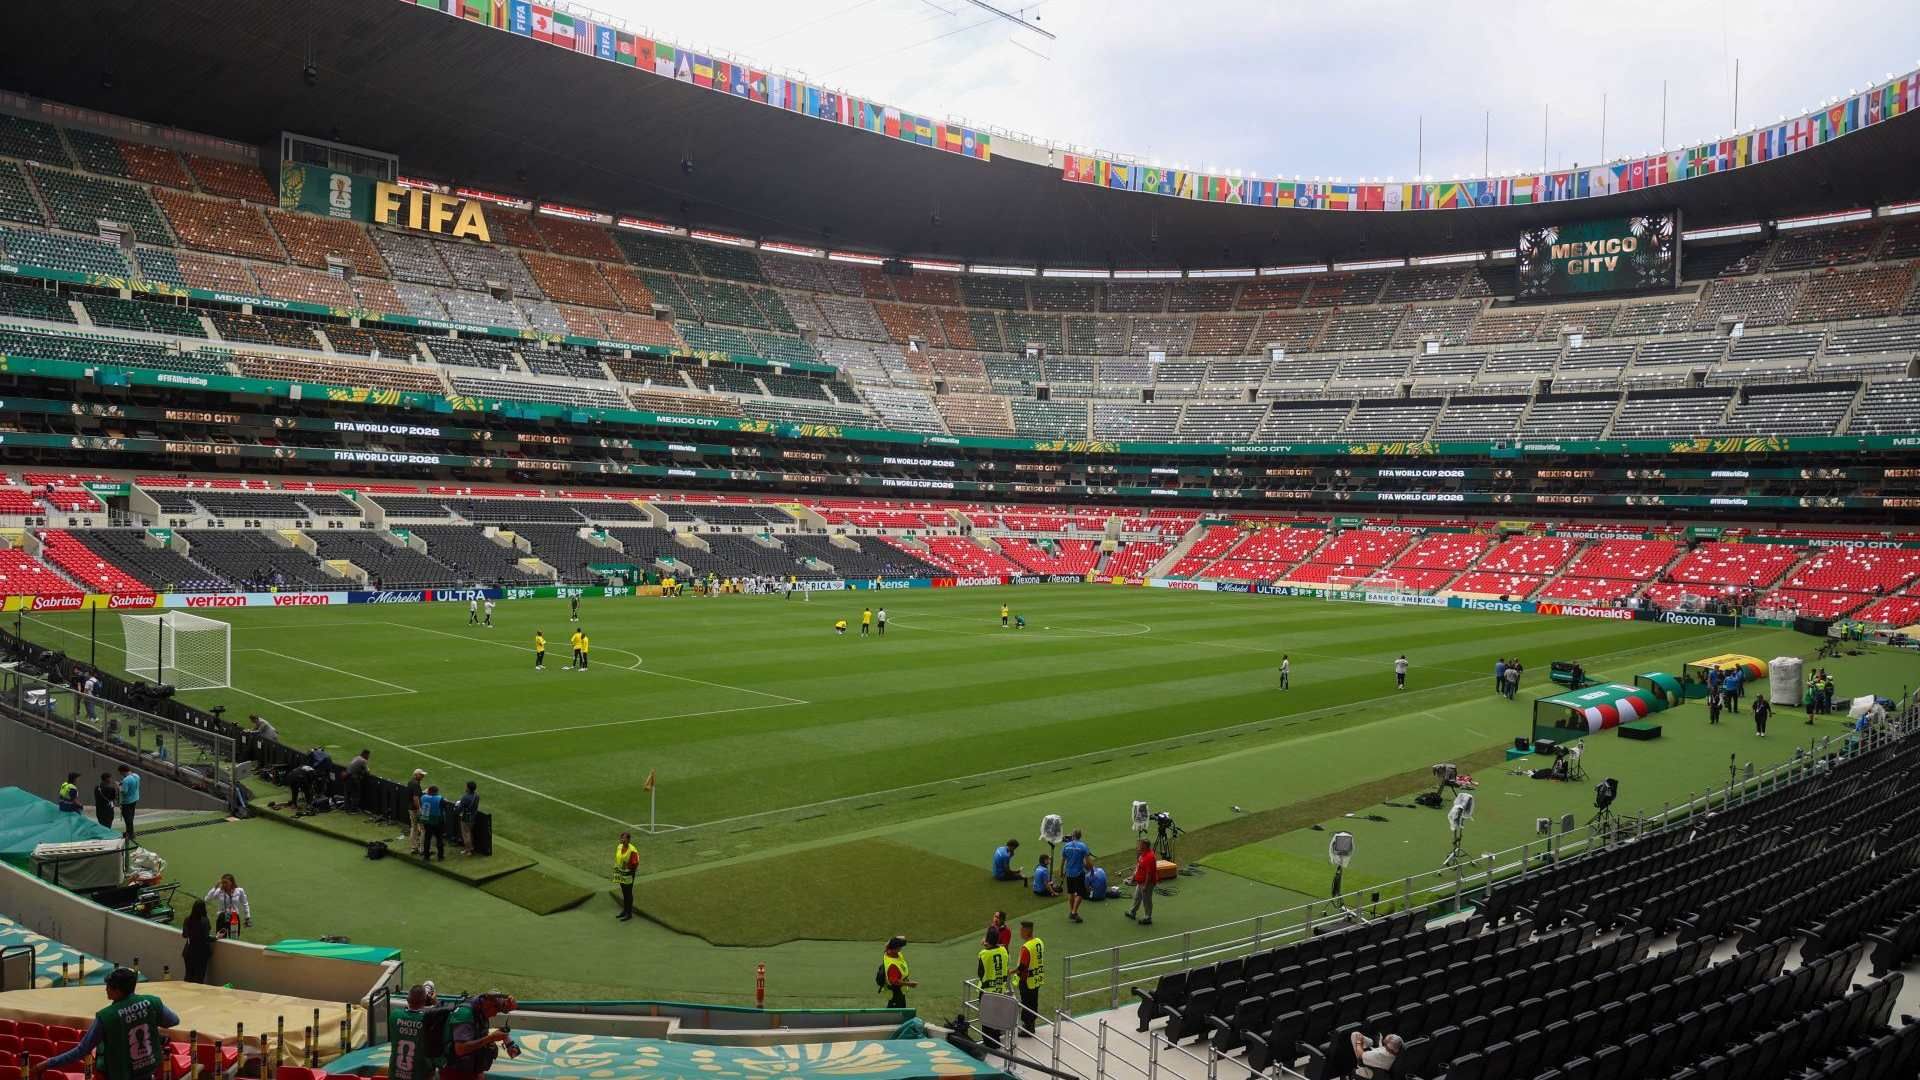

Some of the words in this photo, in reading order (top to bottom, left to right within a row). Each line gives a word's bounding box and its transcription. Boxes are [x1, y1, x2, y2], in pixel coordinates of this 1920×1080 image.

[517, 5, 527, 31] FIFA
[602, 31, 611, 56] FIFA
[375, 181, 491, 243] FIFA
[1551, 236, 1638, 260] MEXICO
[1567, 256, 1619, 275] CITY
[214, 293, 260, 305] MEXICO
[262, 300, 289, 309] CITY
[418, 319, 432, 327] FIFA
[432, 321, 454, 330] WORLD
[597, 341, 629, 350] MEXICO
[157, 374, 208, 386] #FIFAWorldCup
[166, 410, 212, 422] MEXICO
[214, 413, 241, 424] CITY
[656, 415, 695, 424] MEXICO
[696, 418, 720, 426] CITY
[334, 421, 355, 431] FIFA
[356, 423, 389, 433] WORLD
[390, 425, 408, 434] CUP
[409, 427, 440, 436] 2026
[517, 434, 551, 444] MEXICO
[552, 436, 572, 444] CITY
[166, 442, 212, 454] MEXICO
[214, 445, 241, 456] CITY
[334, 451, 355, 460] FIFA
[356, 453, 389, 462] WORLD
[390, 454, 408, 463] CUP
[409, 455, 440, 465] 2026
[783, 451, 810, 460] MEXICO
[517, 461, 551, 470] MEXICO
[552, 462, 572, 471] CITY
[897, 458, 919, 466] WORLD
[1537, 470, 1572, 478] MEXICO
[897, 480, 918, 488] WORLD
[1421, 493, 1437, 501] CUP
[1536, 495, 1571, 503] MEXICO
[1808, 539, 1865, 548] MEXICO
[868, 579, 910, 589] Hsense
[956, 575, 1002, 586] McDonald's
[1016, 574, 1040, 584] Rexona
[1052, 574, 1080, 583] Rexona
[1168, 580, 1199, 590] verizon
[1257, 585, 1289, 595] ULTRA
[34, 595, 82, 609] Sabritas
[110, 594, 155, 608] Sabritas
[186, 593, 247, 607] verizon
[273, 593, 329, 606] verizon
[367, 591, 421, 604] Michelob
[437, 590, 486, 601] ULTRA
[1368, 593, 1389, 602] BANK
[1400, 596, 1436, 605] AMERICA
[1461, 599, 1521, 612] Hisense
[1561, 606, 1632, 620] McDonald's
[1666, 612, 1716, 626] Rexona
[117, 999, 151, 1017] PHOTO
[126, 1009, 148, 1023] 0515
[397, 1018, 423, 1029] PHOTO
